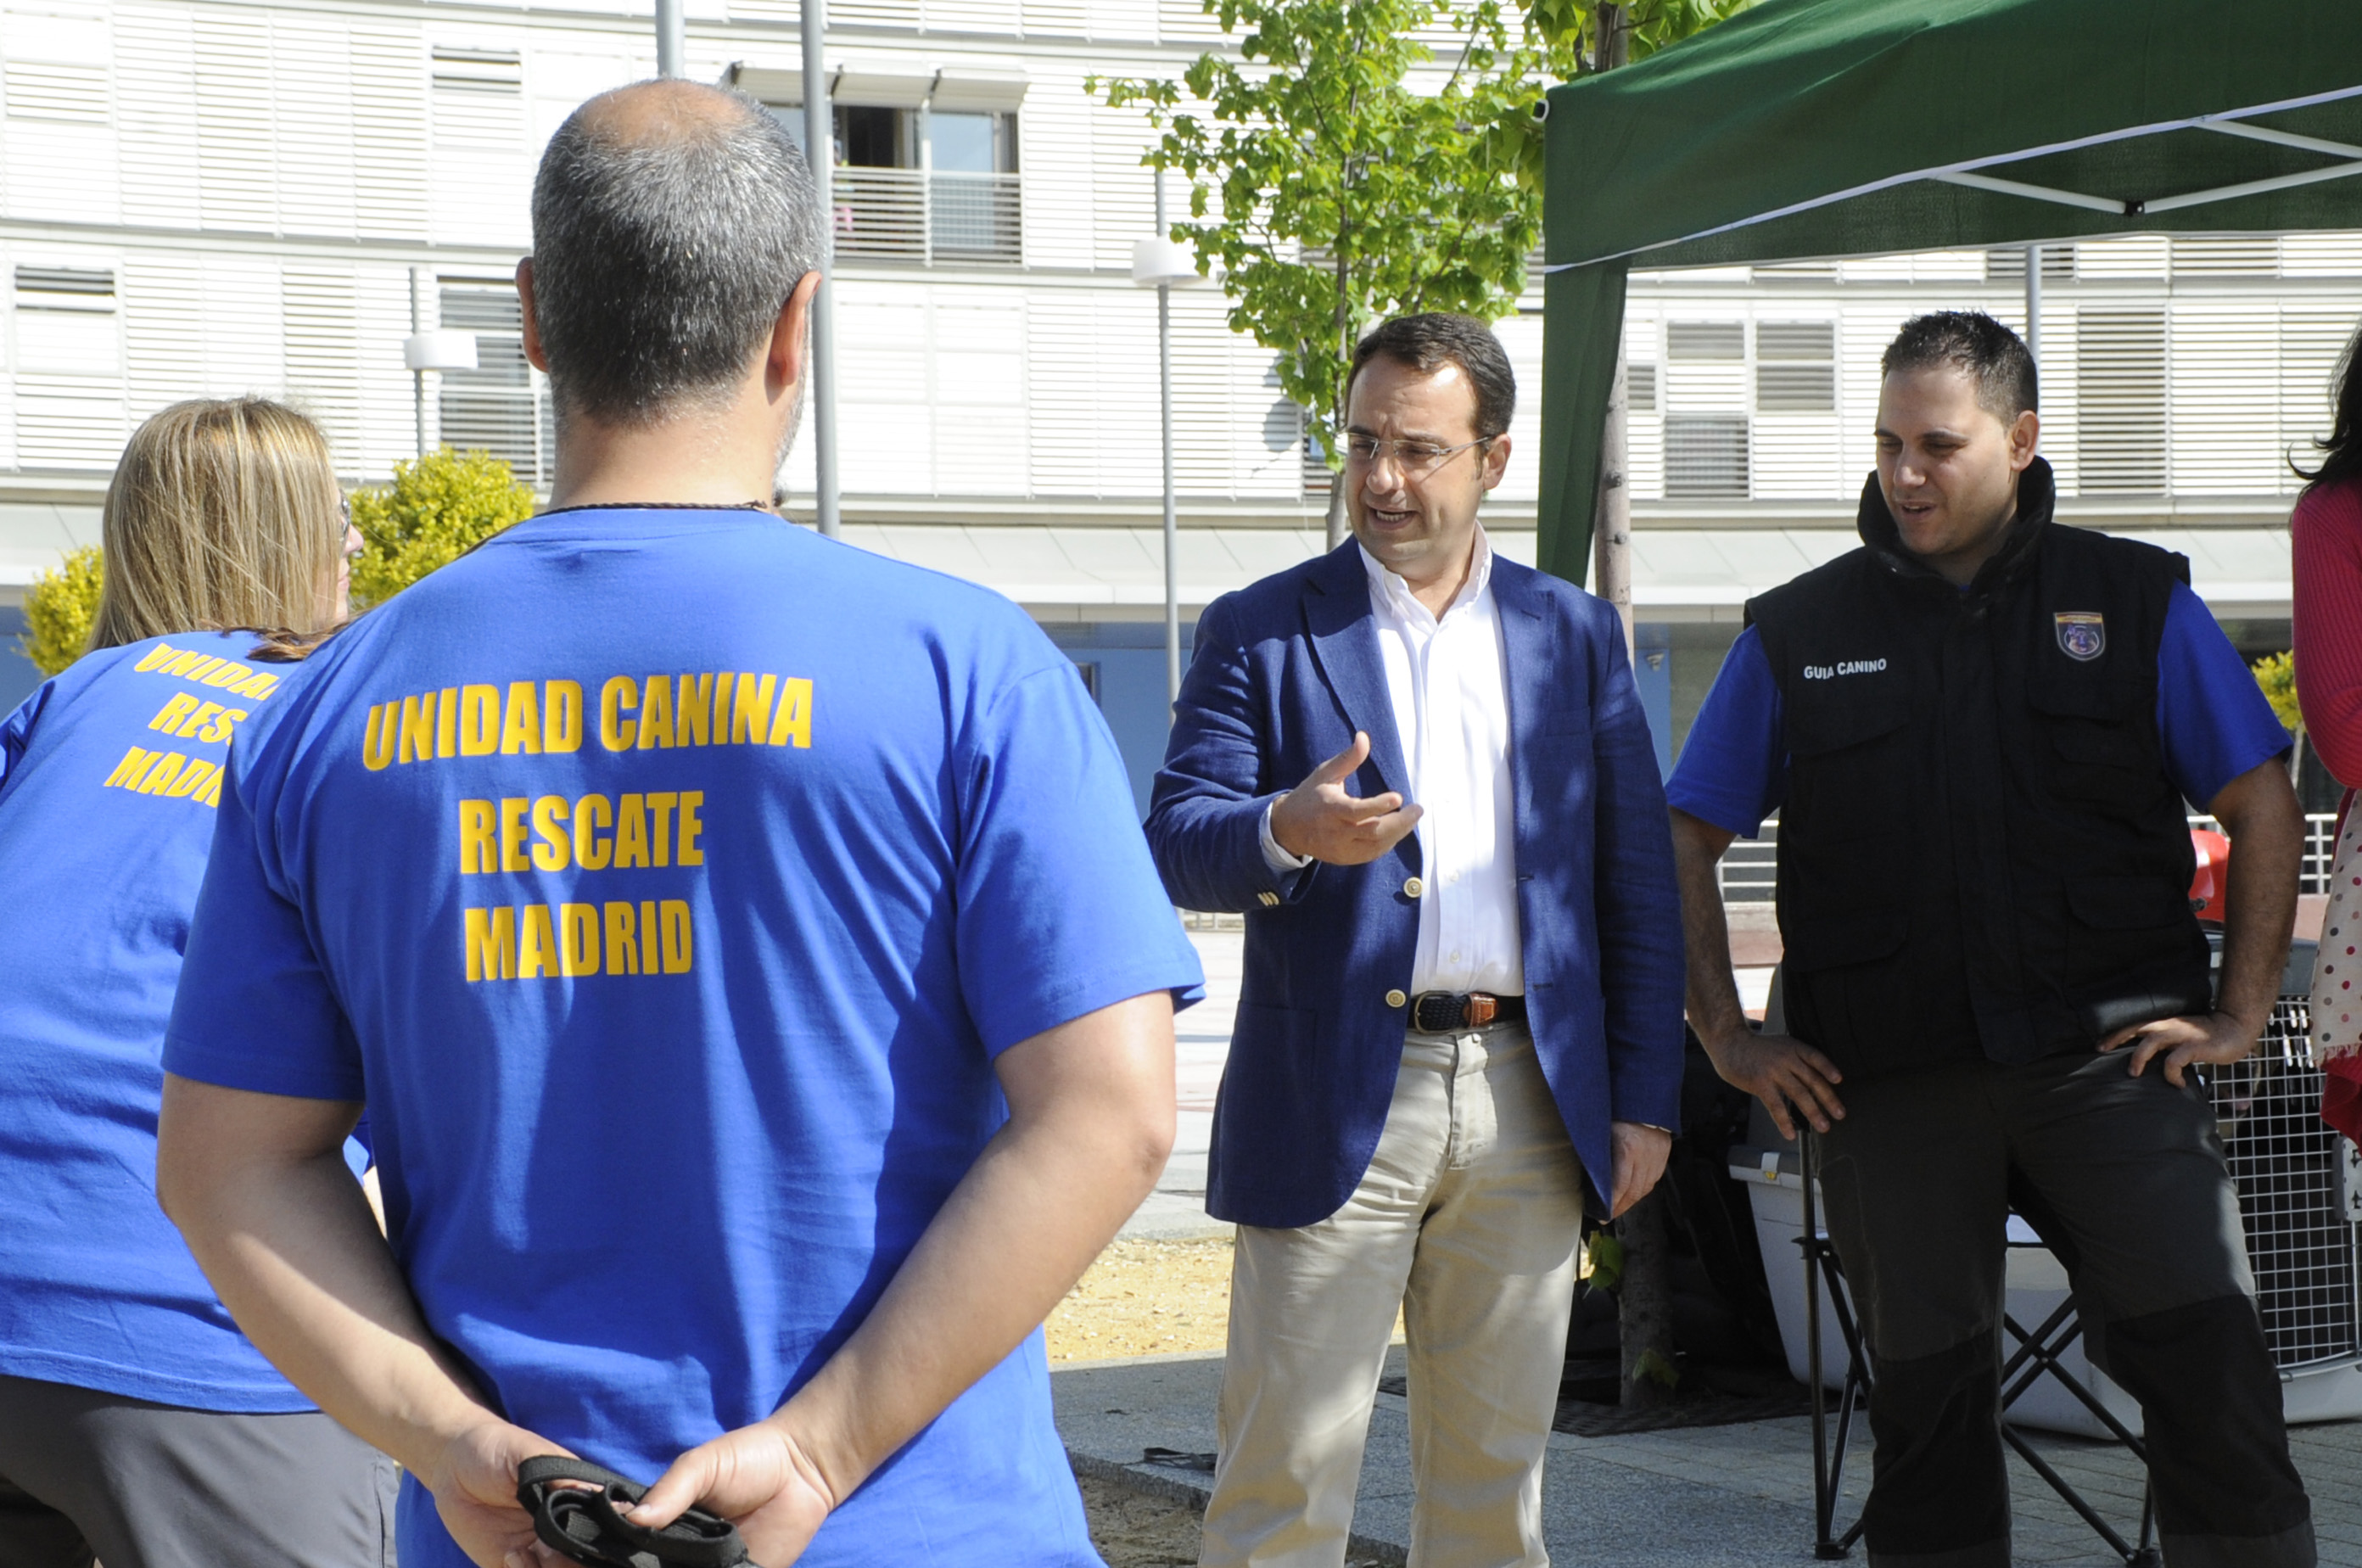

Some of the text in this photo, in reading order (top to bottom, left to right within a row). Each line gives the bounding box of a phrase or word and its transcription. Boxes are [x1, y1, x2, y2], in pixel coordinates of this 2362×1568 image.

[134, 642, 279, 701] UNIDA
[1804, 658, 1887, 680] GUIA CANINO
[148, 692, 249, 747] RES
[363, 672, 813, 771] UNIDAD CANINA
[459, 791, 703, 873] RESCATE
[465, 899, 692, 982] MADRID
